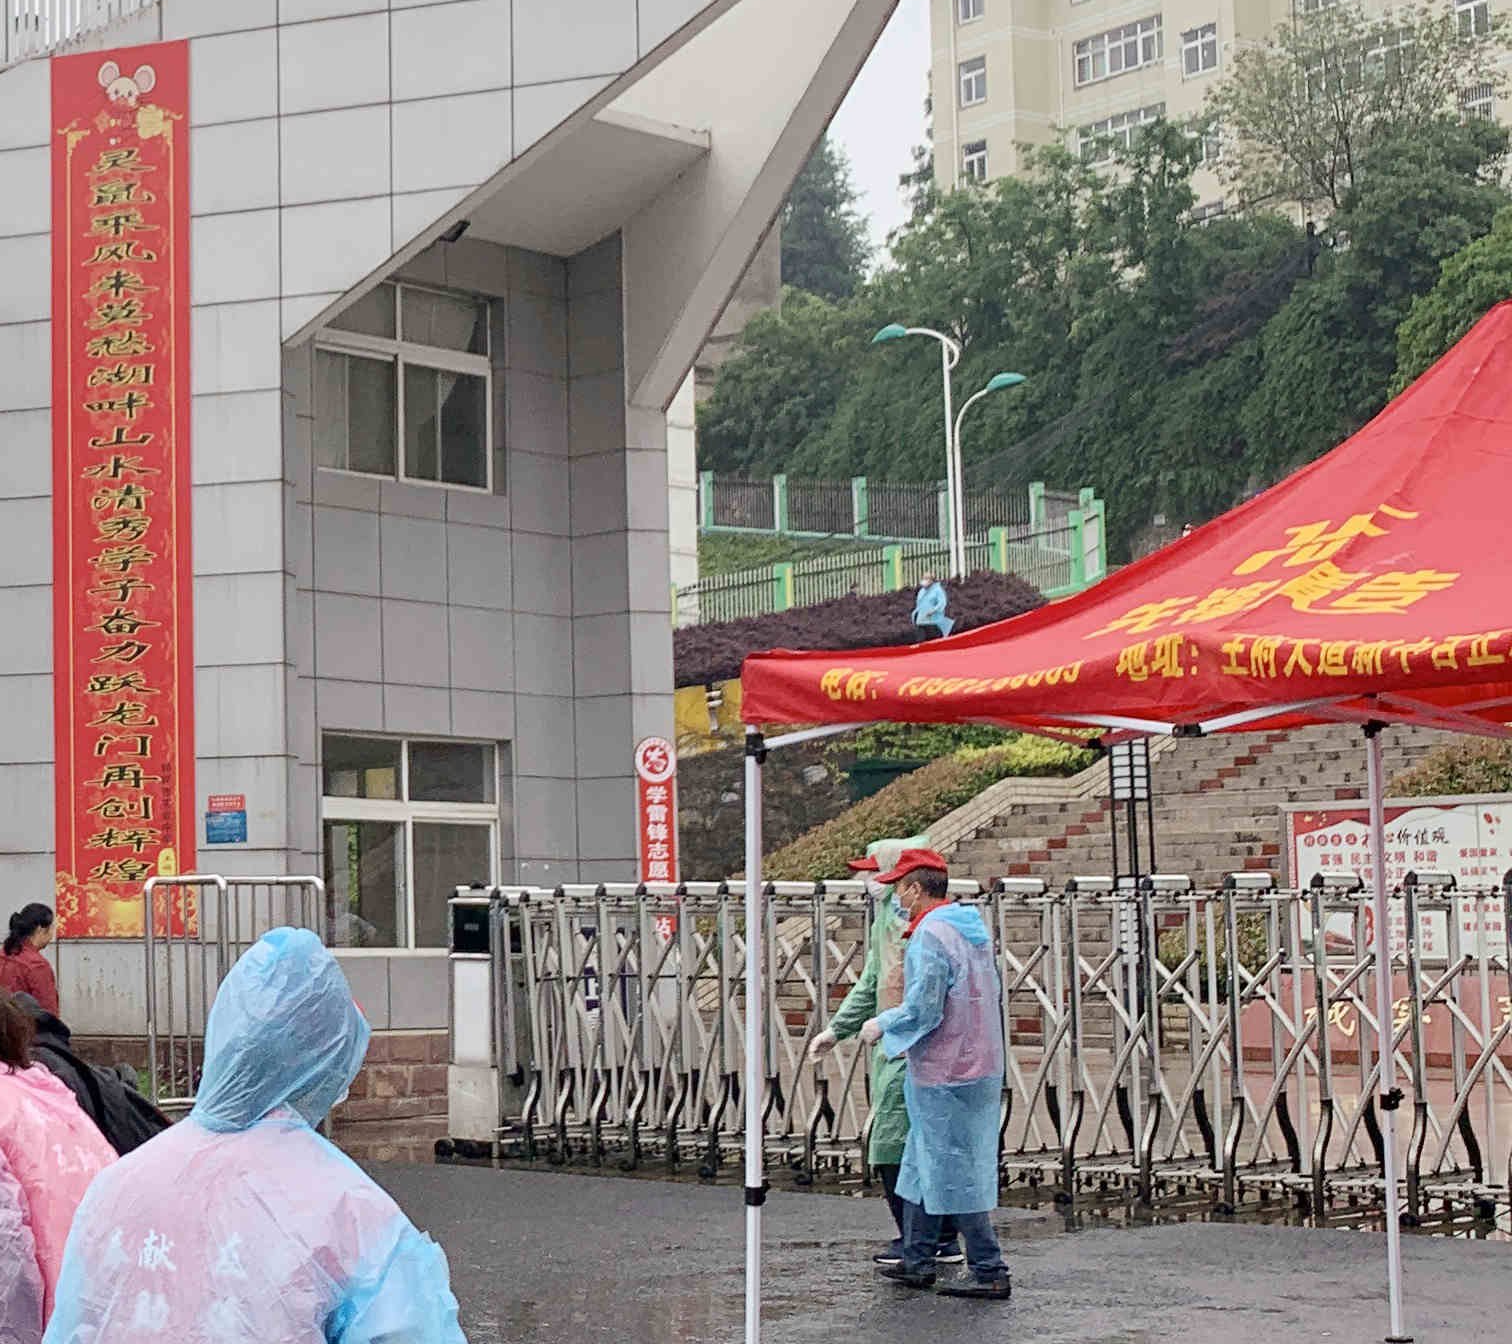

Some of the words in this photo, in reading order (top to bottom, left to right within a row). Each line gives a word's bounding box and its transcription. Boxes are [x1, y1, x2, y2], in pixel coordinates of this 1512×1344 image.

[645, 785, 670, 935] 学雷锋志愿站
